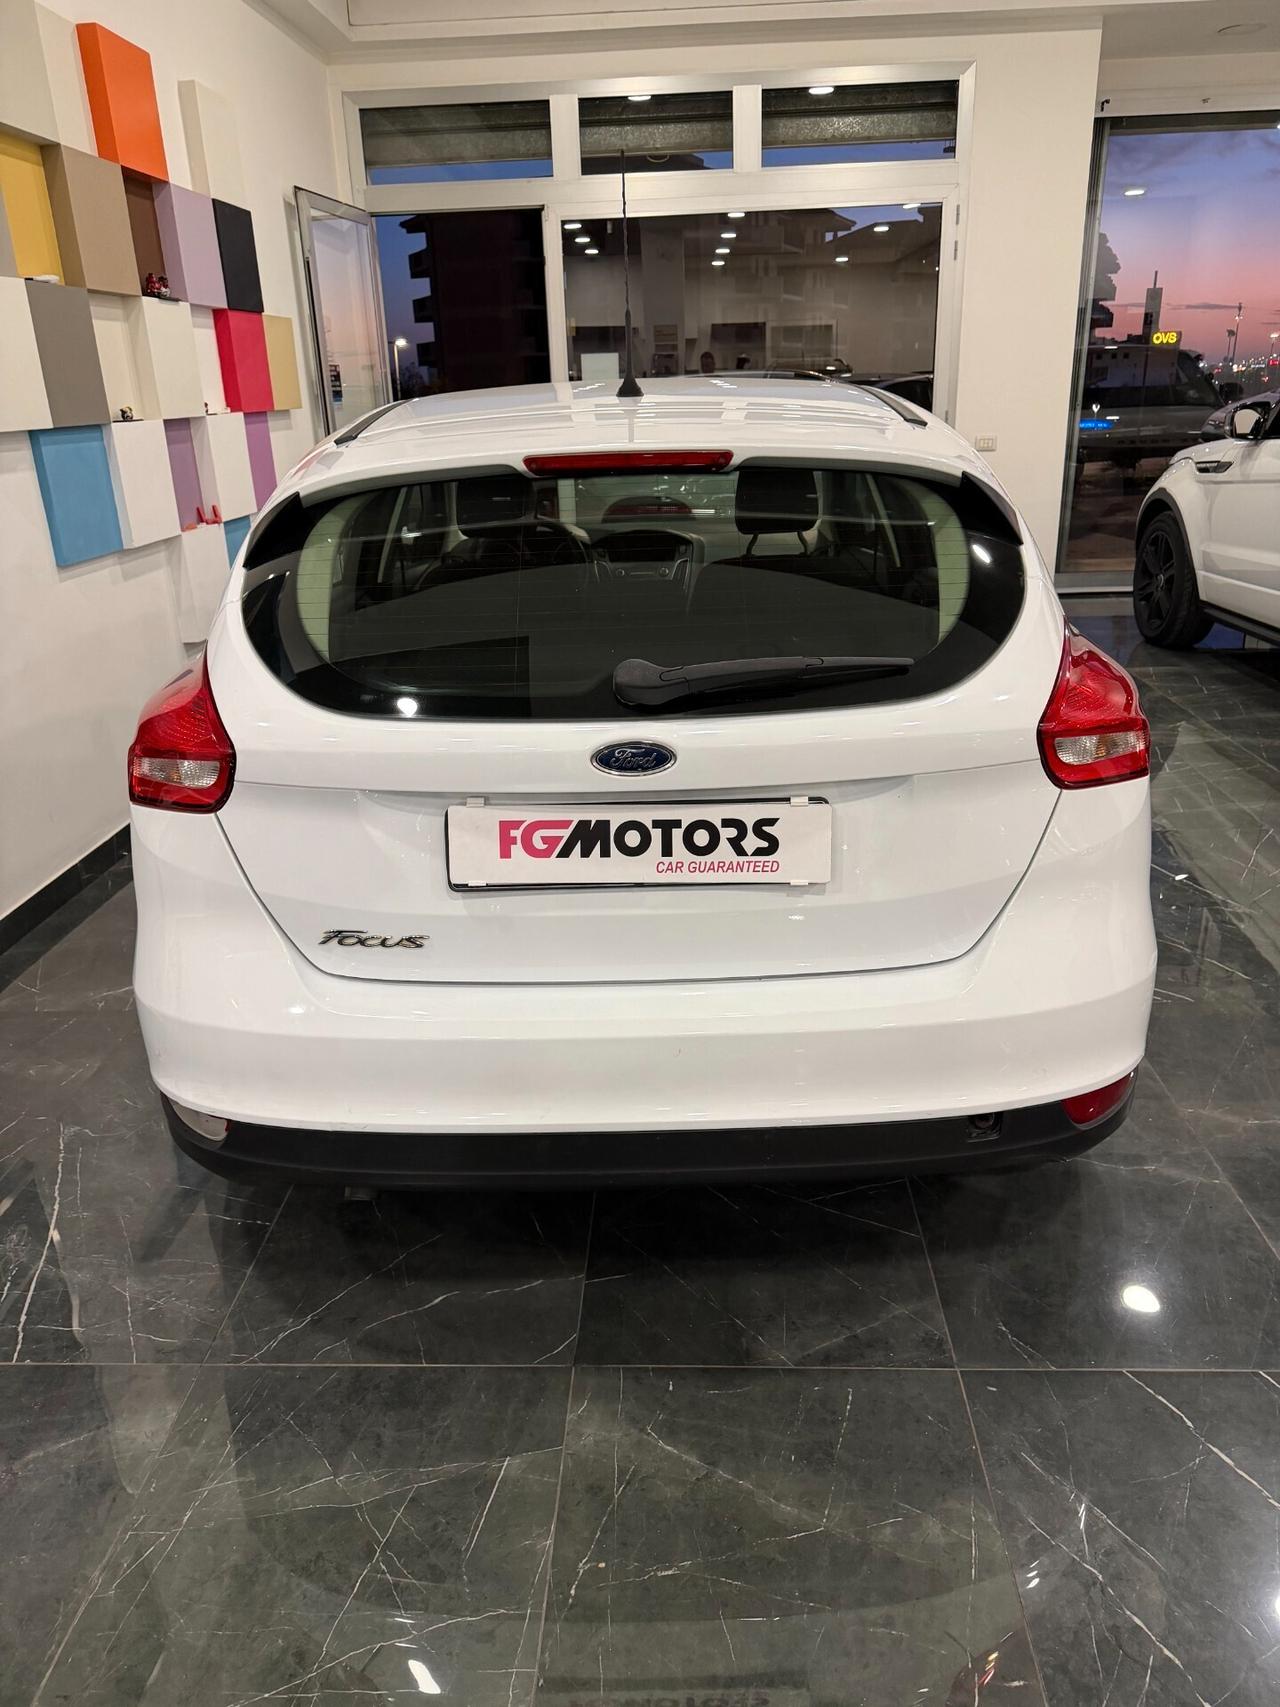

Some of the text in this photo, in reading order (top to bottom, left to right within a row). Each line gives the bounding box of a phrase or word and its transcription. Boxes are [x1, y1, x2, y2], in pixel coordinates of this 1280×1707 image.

[610, 748, 657, 768] Ford
[498, 817, 781, 859] FGMOTORS
[656, 860, 780, 874] CAR GUARANTEED
